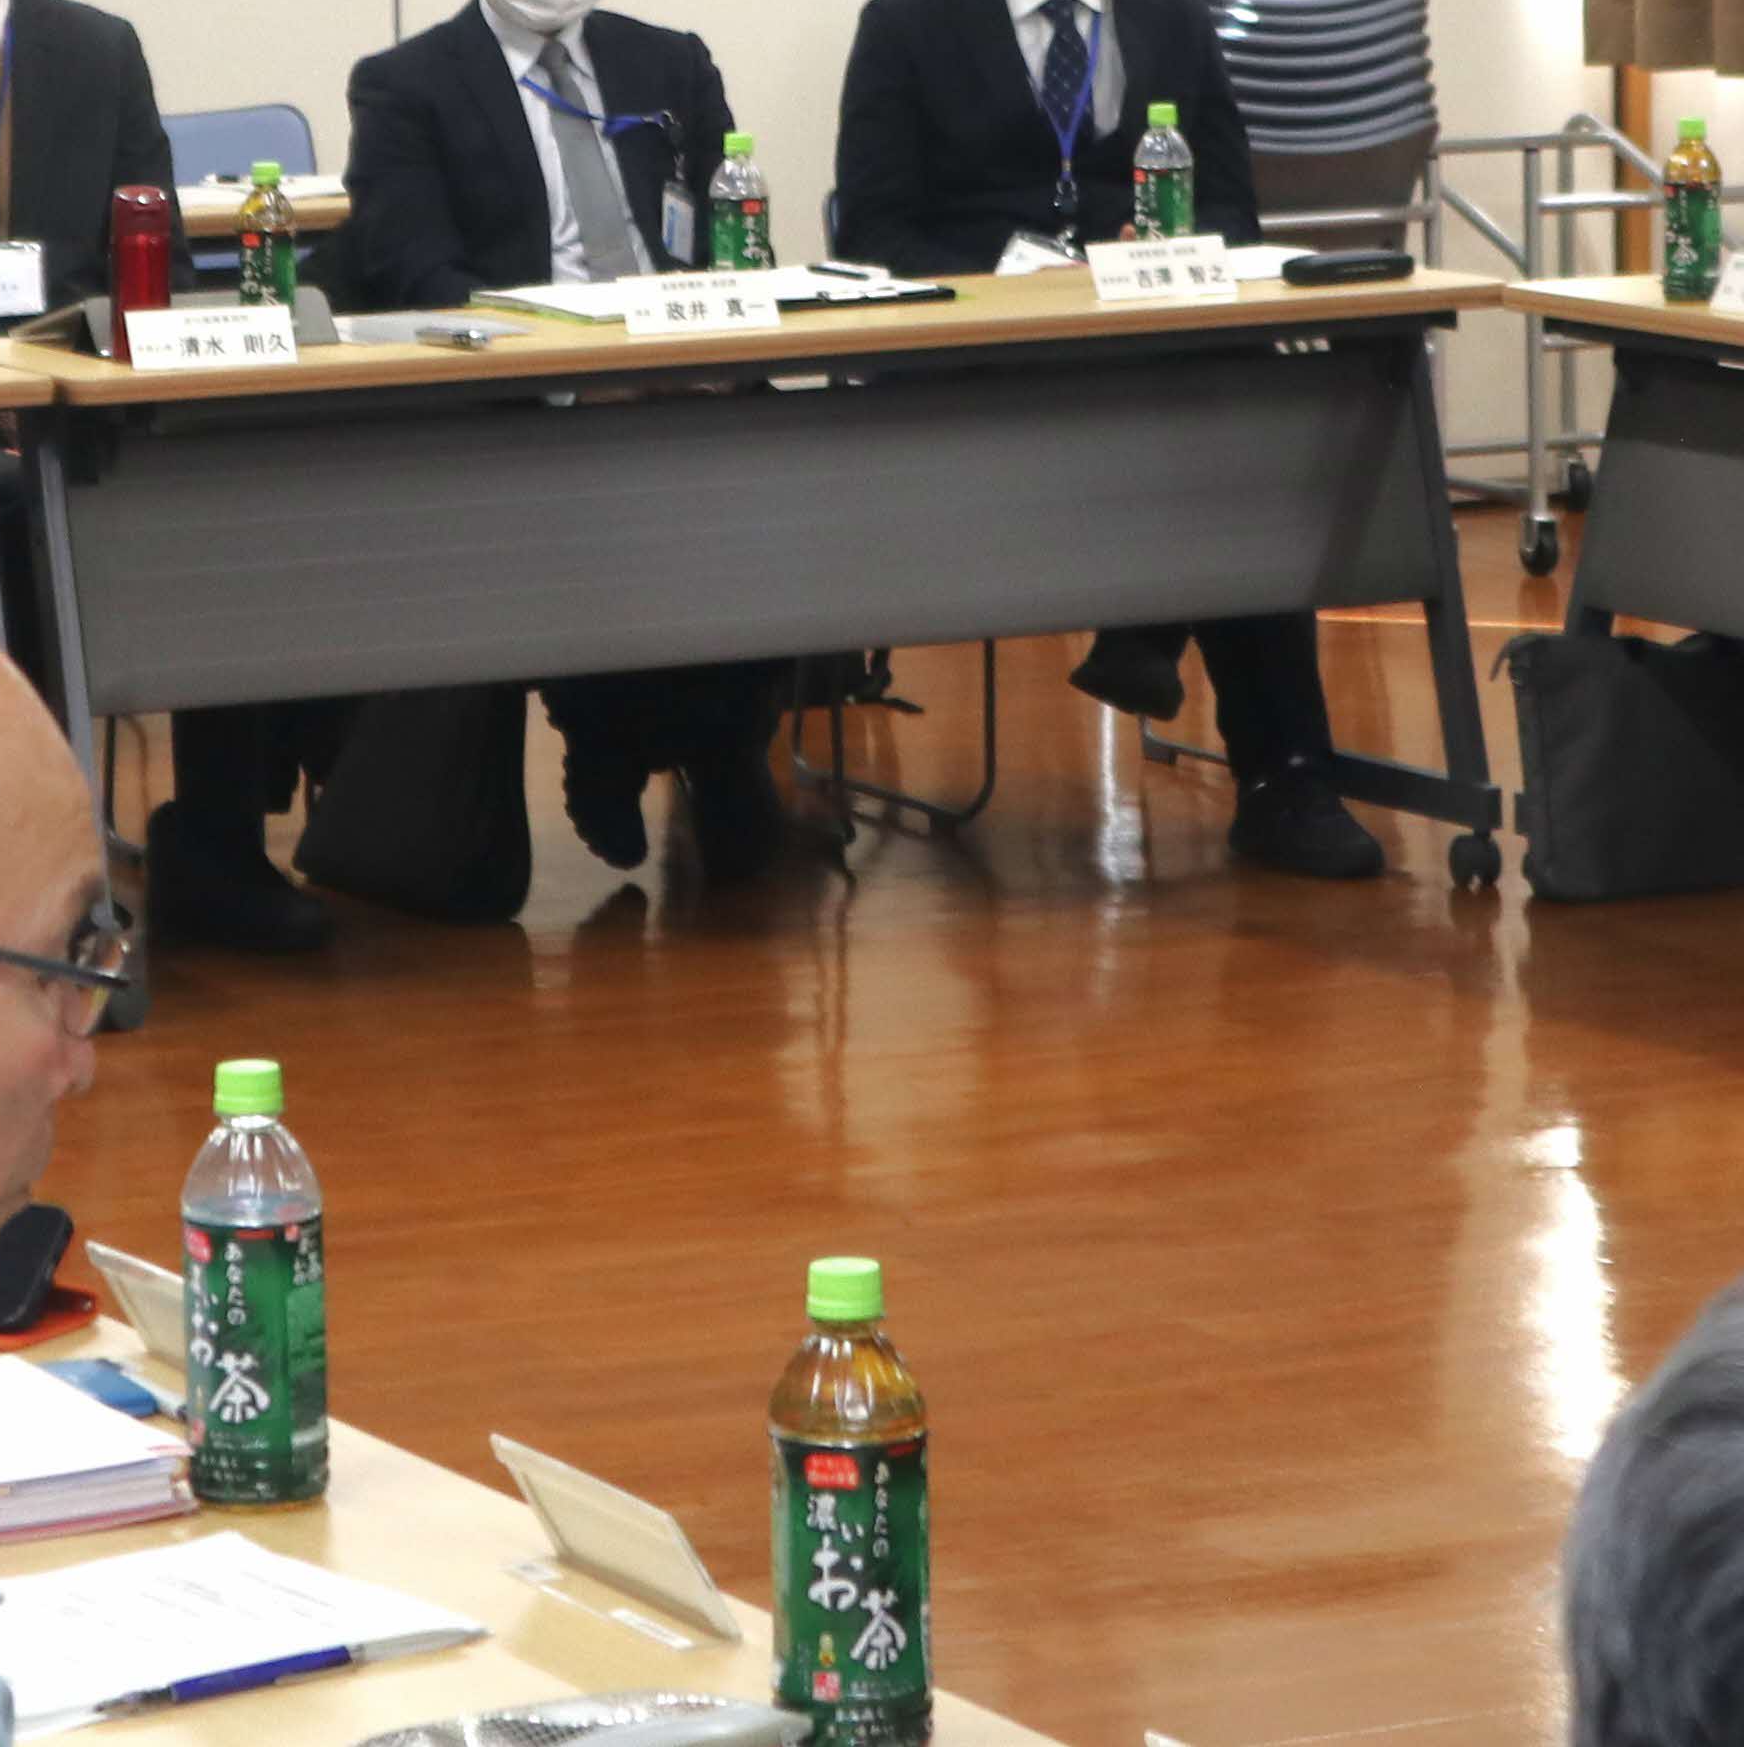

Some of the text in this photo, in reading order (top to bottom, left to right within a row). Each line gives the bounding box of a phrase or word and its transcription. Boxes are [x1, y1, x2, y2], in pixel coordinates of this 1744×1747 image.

[180, 335, 226, 357] 清水
[224, 1240, 247, 1326] あなたの
[872, 1460, 891, 1559] あなたの
[806, 1492, 907, 1671] 濃いお茶
